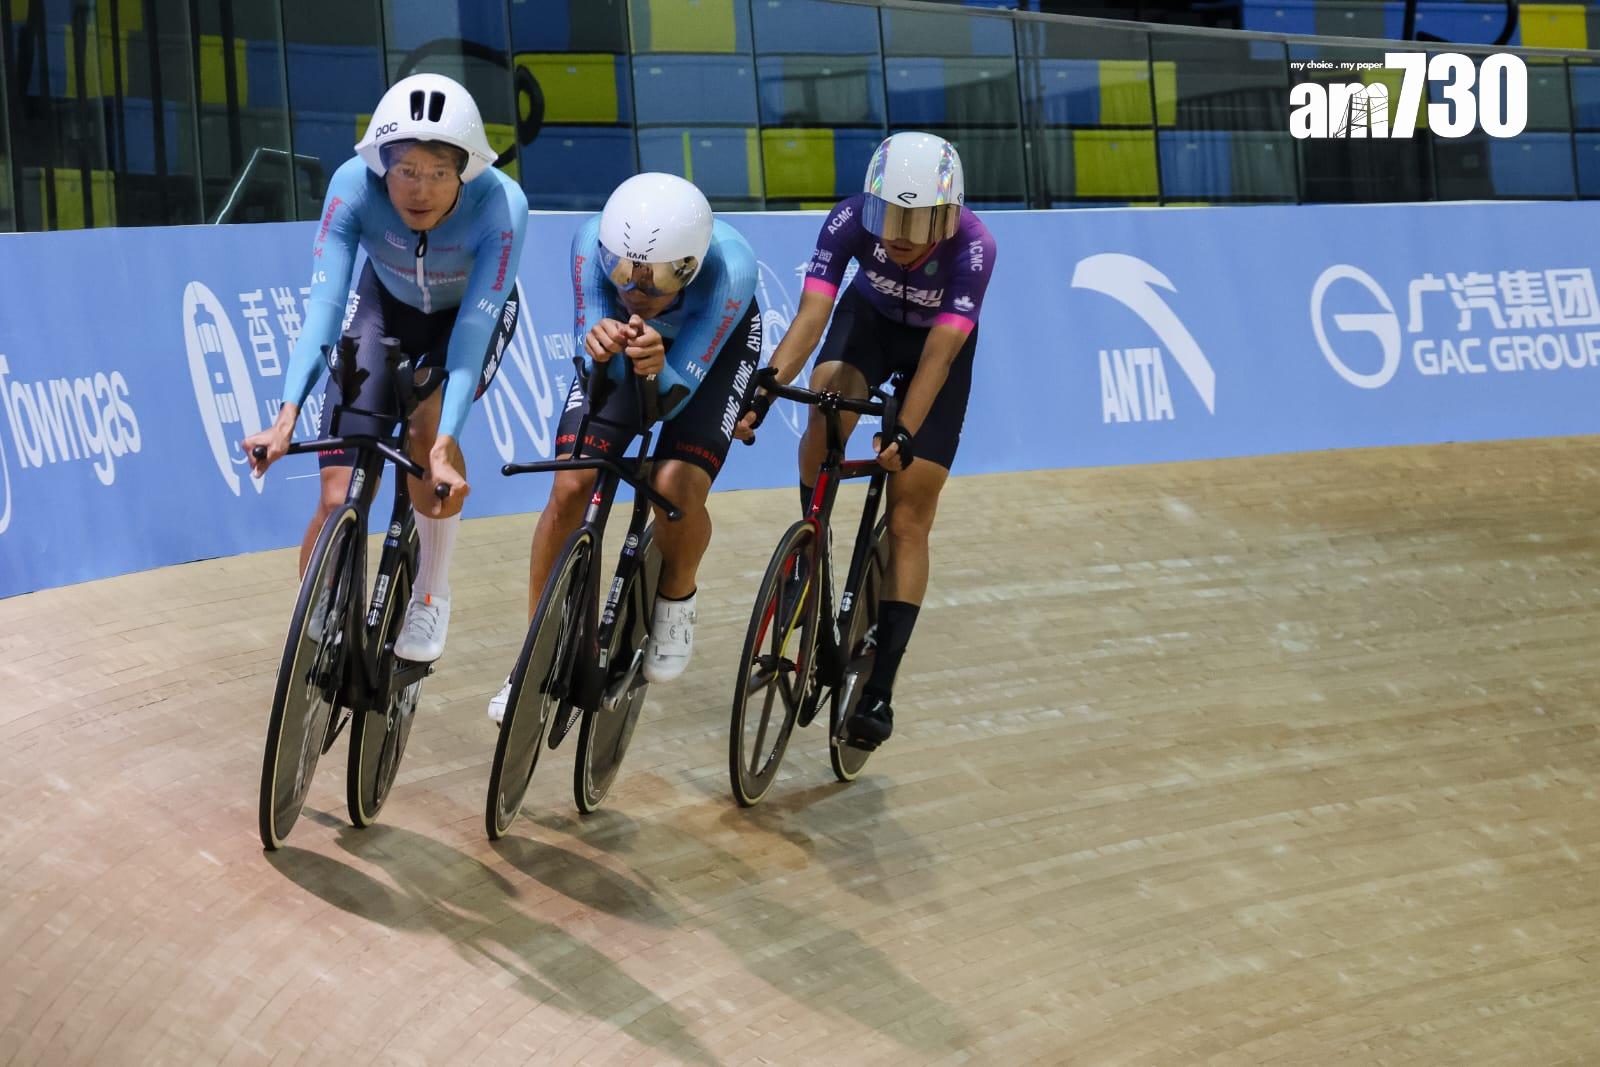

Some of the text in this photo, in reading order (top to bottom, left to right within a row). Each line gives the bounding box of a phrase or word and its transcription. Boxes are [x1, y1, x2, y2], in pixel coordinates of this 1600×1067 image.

[828, 206, 853, 235] ACMC
[968, 240, 983, 272] ACMC
[477, 298, 500, 319] HKG
[503, 299, 517, 332] CHINA
[1407, 268, 1600, 333] 广汽集团
[544, 333, 575, 360] NEW
[1413, 338, 1487, 375] GAC
[721, 396, 741, 441] HONG
[747, 313, 760, 353] CHINA
[1099, 347, 1175, 423] ANTA
